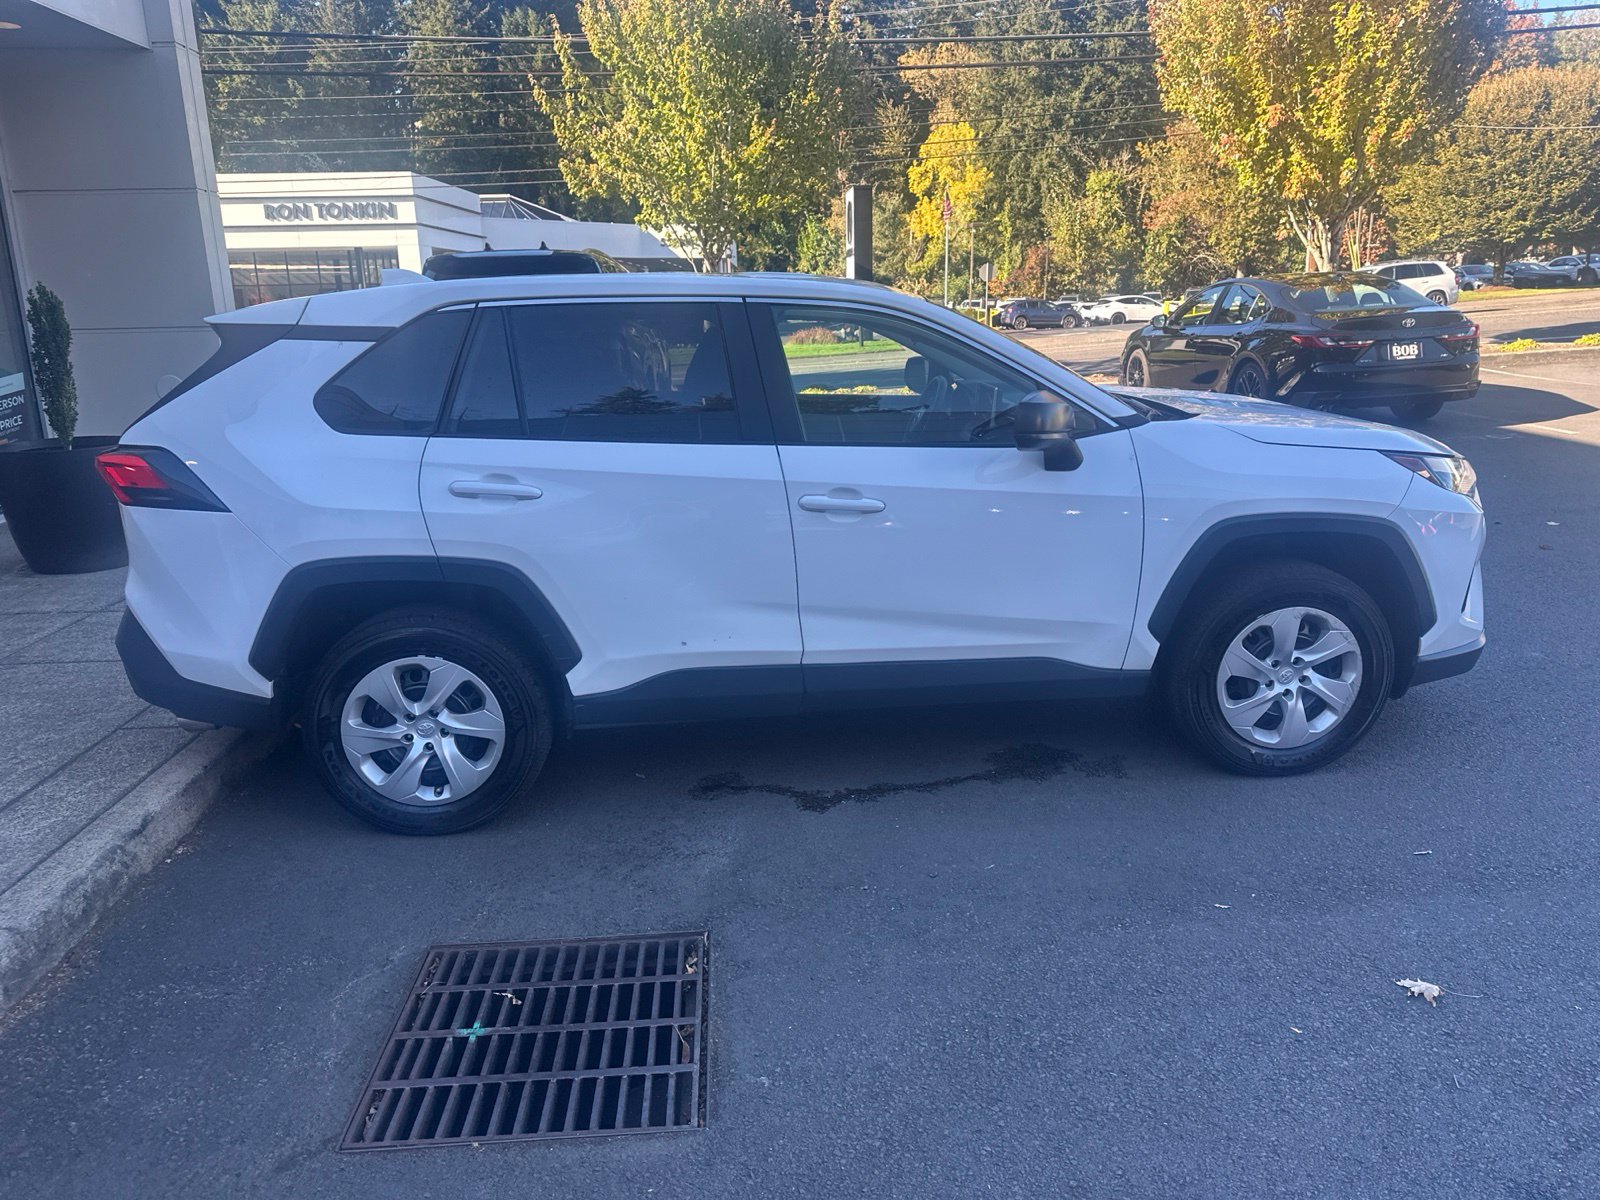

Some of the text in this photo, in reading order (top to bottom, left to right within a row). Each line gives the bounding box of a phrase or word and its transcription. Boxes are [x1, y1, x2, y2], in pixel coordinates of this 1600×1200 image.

[263, 202, 398, 221] RON TONKIN
[1392, 344, 1419, 357] BOB
[0, 415, 22, 430] PRICE
